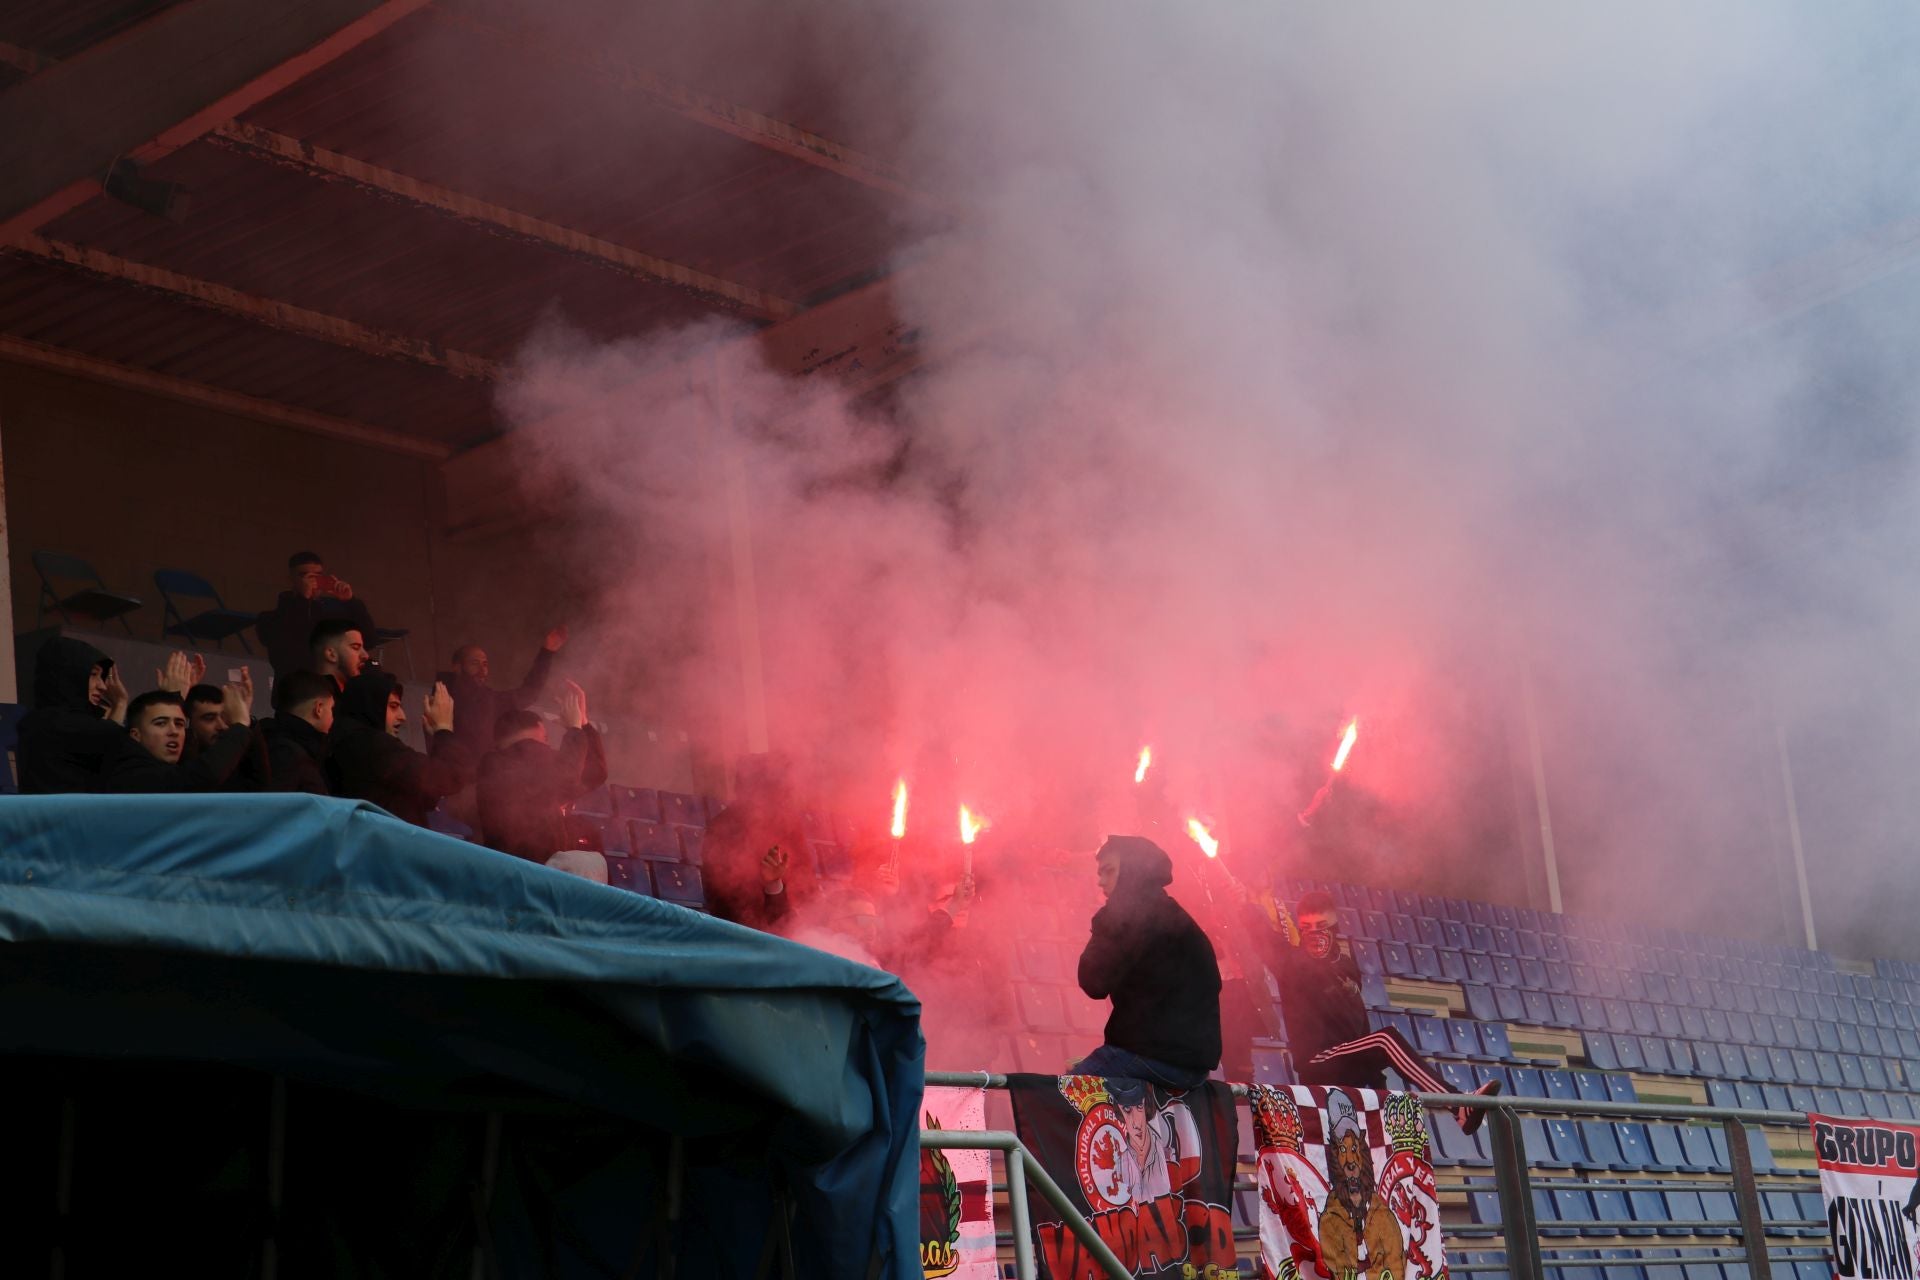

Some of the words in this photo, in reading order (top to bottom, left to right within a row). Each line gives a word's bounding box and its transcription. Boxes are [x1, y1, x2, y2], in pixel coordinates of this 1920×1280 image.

[1080, 1119, 1097, 1194] CULTURAL
[1095, 1110, 1102, 1121] Y
[1815, 1122, 1916, 1169] GRUPO
